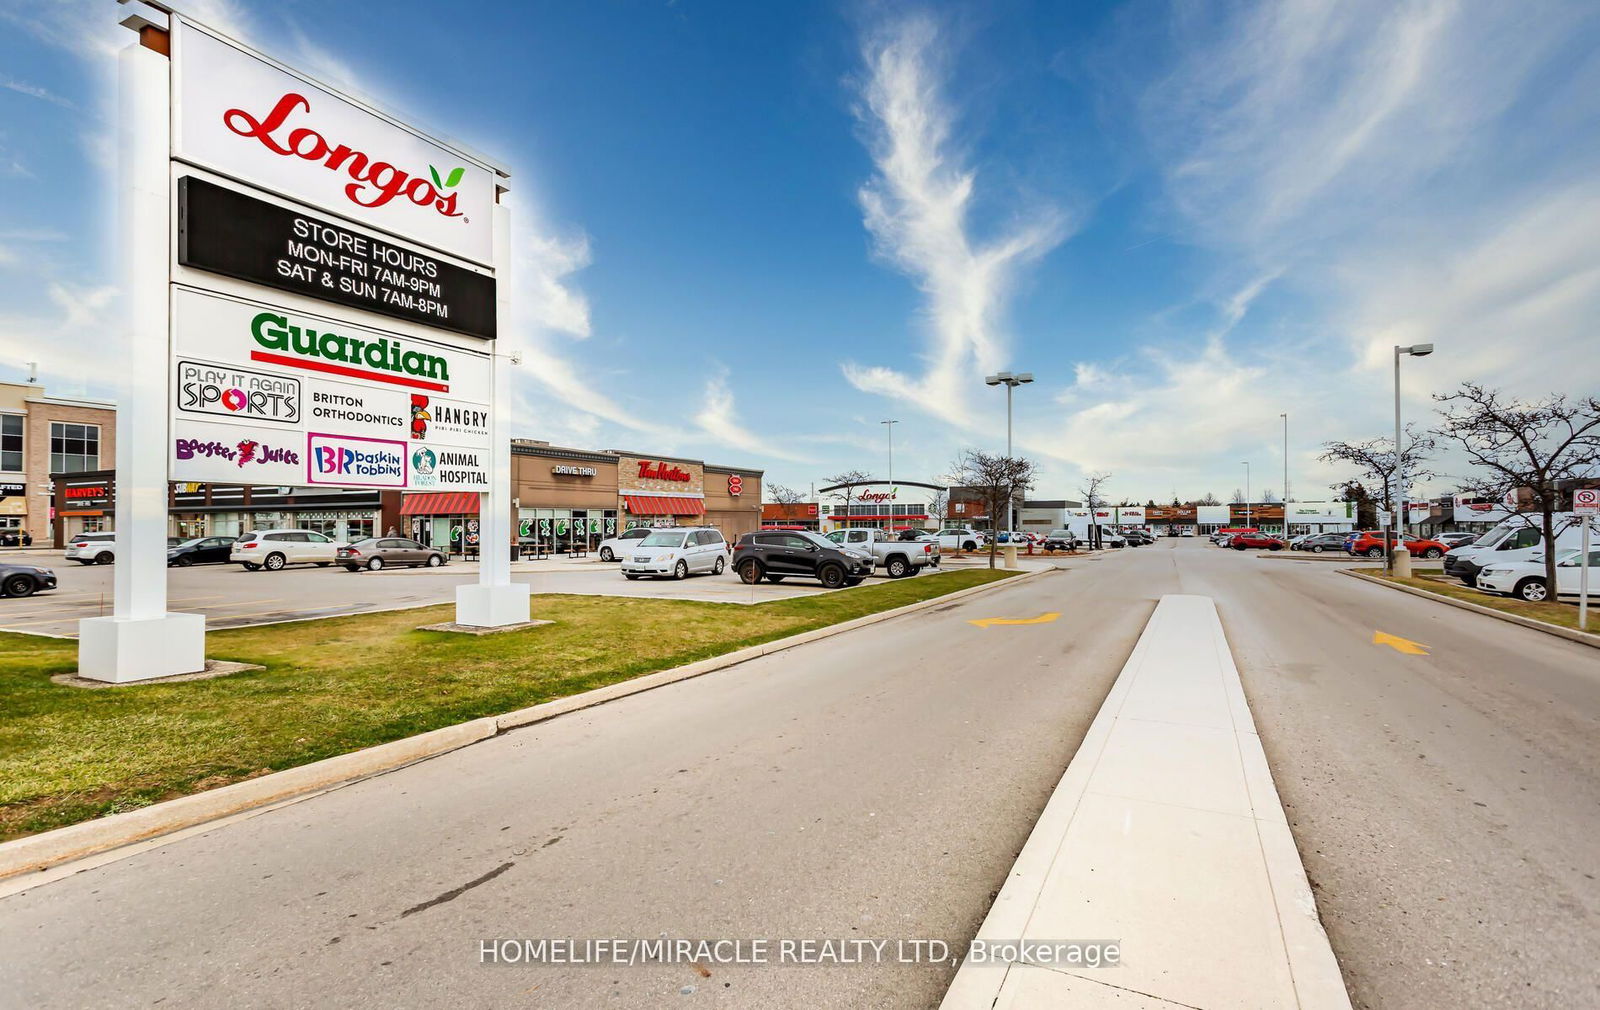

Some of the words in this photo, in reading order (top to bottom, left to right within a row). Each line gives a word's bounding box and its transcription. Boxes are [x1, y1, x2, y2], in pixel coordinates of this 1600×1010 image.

[293, 218, 367, 257] STORE
[373, 247, 438, 278] HOURS
[288, 240, 368, 282] MON-FRI
[373, 265, 441, 298] 7AM-9PM
[276, 260, 316, 282] SAT
[321, 272, 334, 289] &
[340, 278, 377, 301] SUN
[381, 288, 448, 319] 7AM-8PM
[251, 312, 449, 381] Guardian
[185, 367, 226, 385] PLAY
[231, 374, 245, 387] IT
[250, 377, 296, 395] AGAIN
[183, 382, 297, 418] SPORTS
[313, 392, 363, 407] BRITTON
[313, 407, 403, 427] ORTHODONTICS
[435, 406, 488, 428] HANGRY
[176, 439, 237, 461] Booster
[256, 445, 299, 465] Juice
[315, 446, 355, 475] BR
[354, 450, 400, 466] baskin
[439, 452, 479, 467] ANIMAL
[356, 464, 401, 477] robbins
[440, 470, 488, 485] HOSPITAL
[578, 467, 597, 476] THRU
